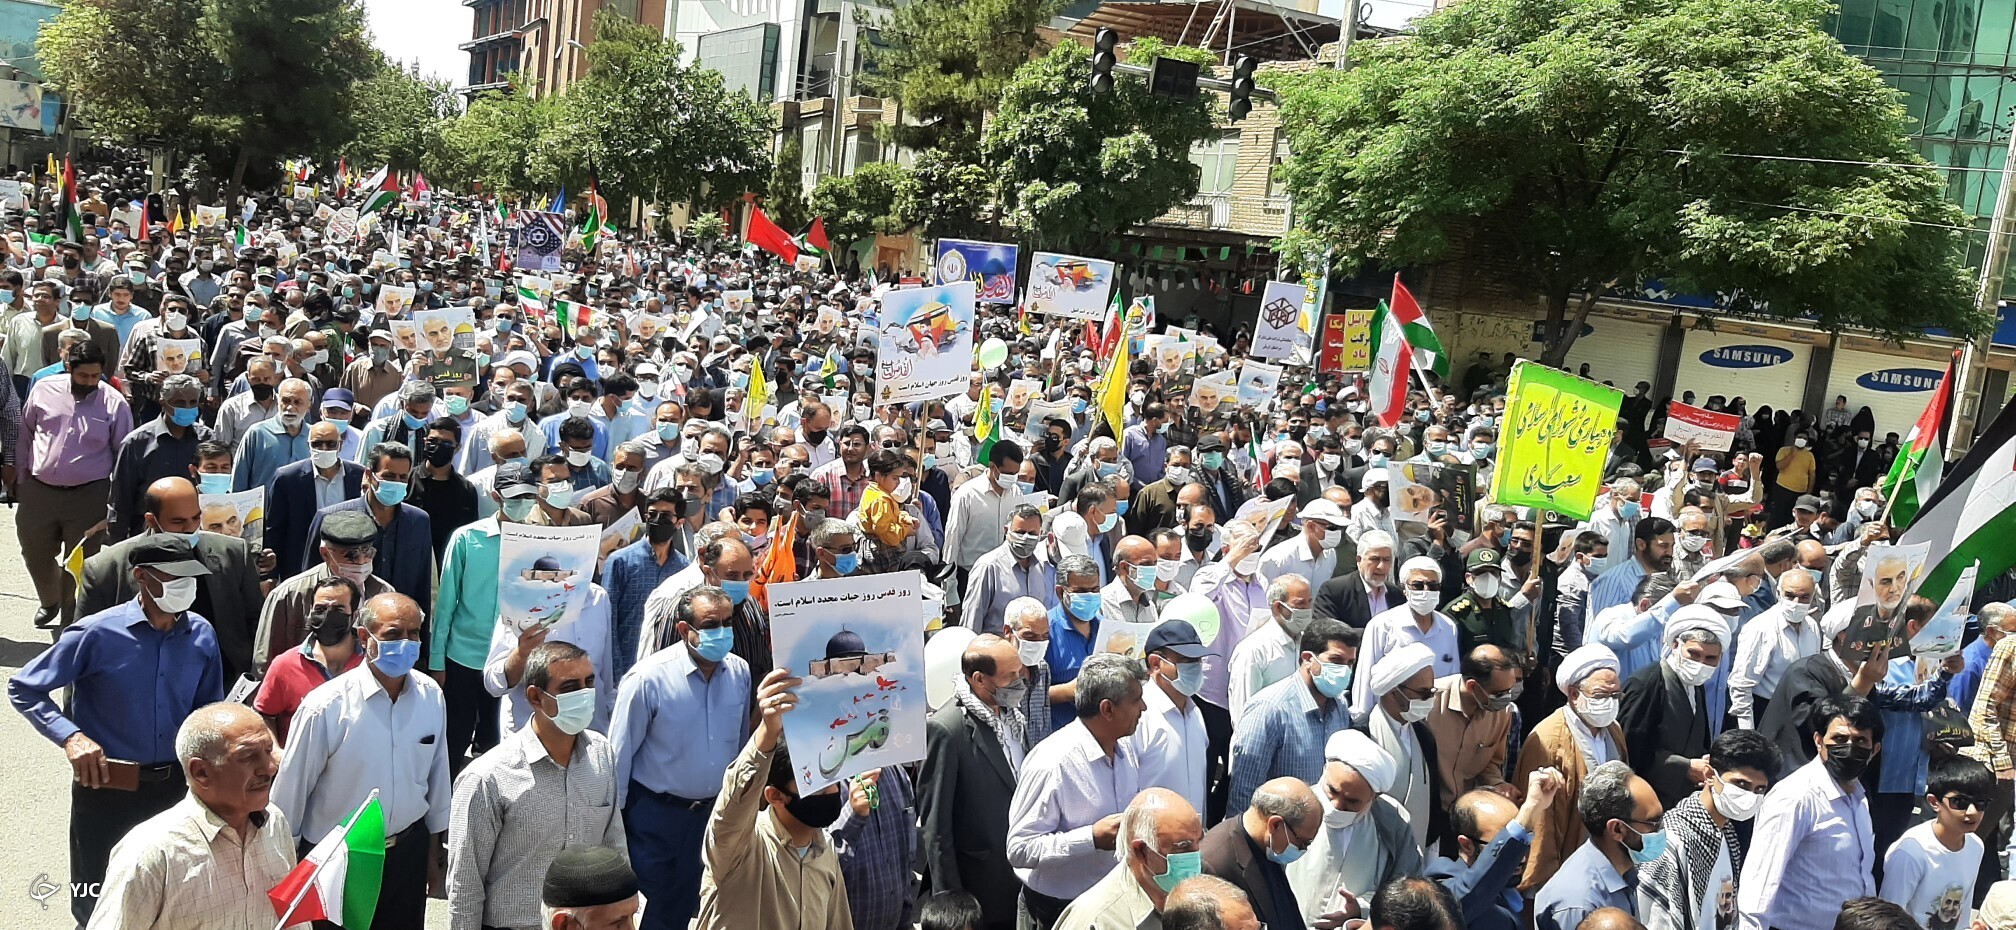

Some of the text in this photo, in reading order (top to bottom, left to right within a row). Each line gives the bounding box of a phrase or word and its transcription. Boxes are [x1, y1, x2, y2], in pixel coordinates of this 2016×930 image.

[1713, 348, 1781, 366] SAMSUNG
[910, 381, 925, 391] اسلام
[1870, 370, 1942, 391] SAMSUNG
[839, 592, 860, 603] حیات
[861, 592, 876, 602] روز
[876, 586, 896, 600] قدس
[897, 588, 911, 598] روز
[795, 595, 815, 608] اسلام
[817, 596, 839, 605] مجدد
